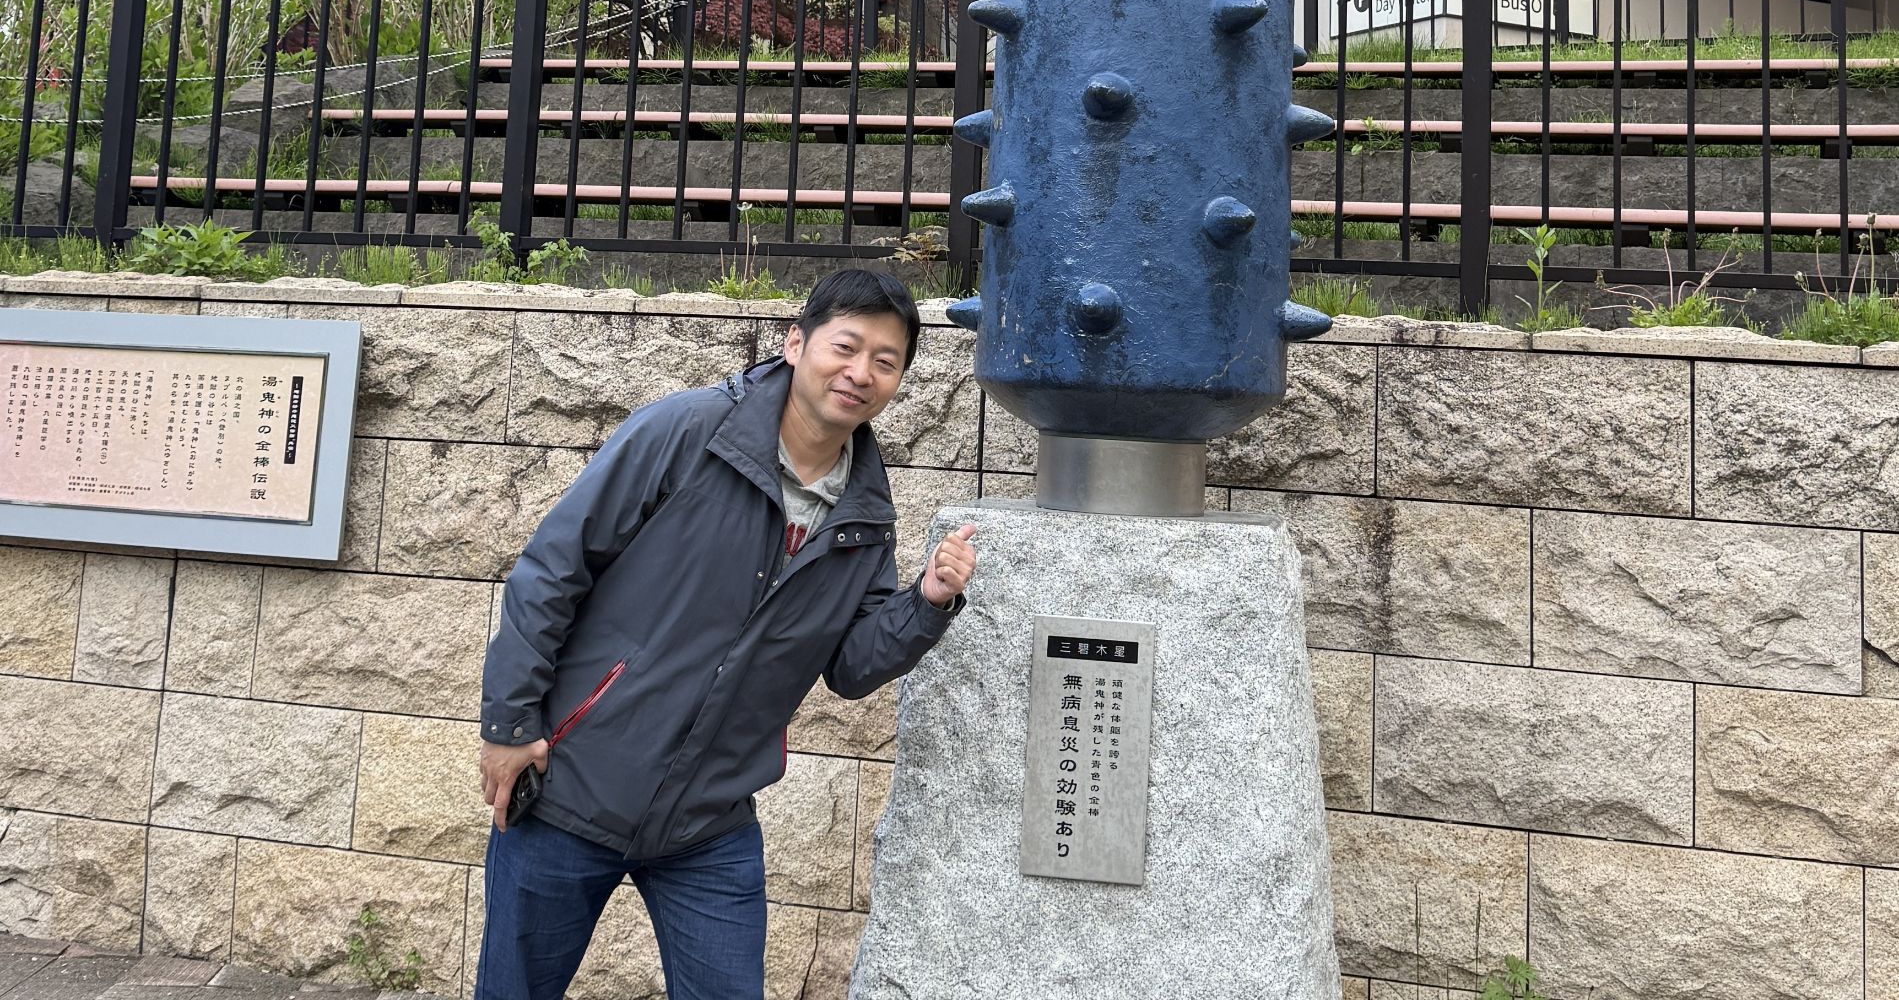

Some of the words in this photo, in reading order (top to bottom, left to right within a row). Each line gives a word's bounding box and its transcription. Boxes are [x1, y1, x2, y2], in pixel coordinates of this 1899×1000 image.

[250, 376, 278, 500] 湯鬼神の金棒伝説
[1059, 641, 1125, 658] 三碧木星
[1055, 674, 1083, 858] 無病息災の効験あり
